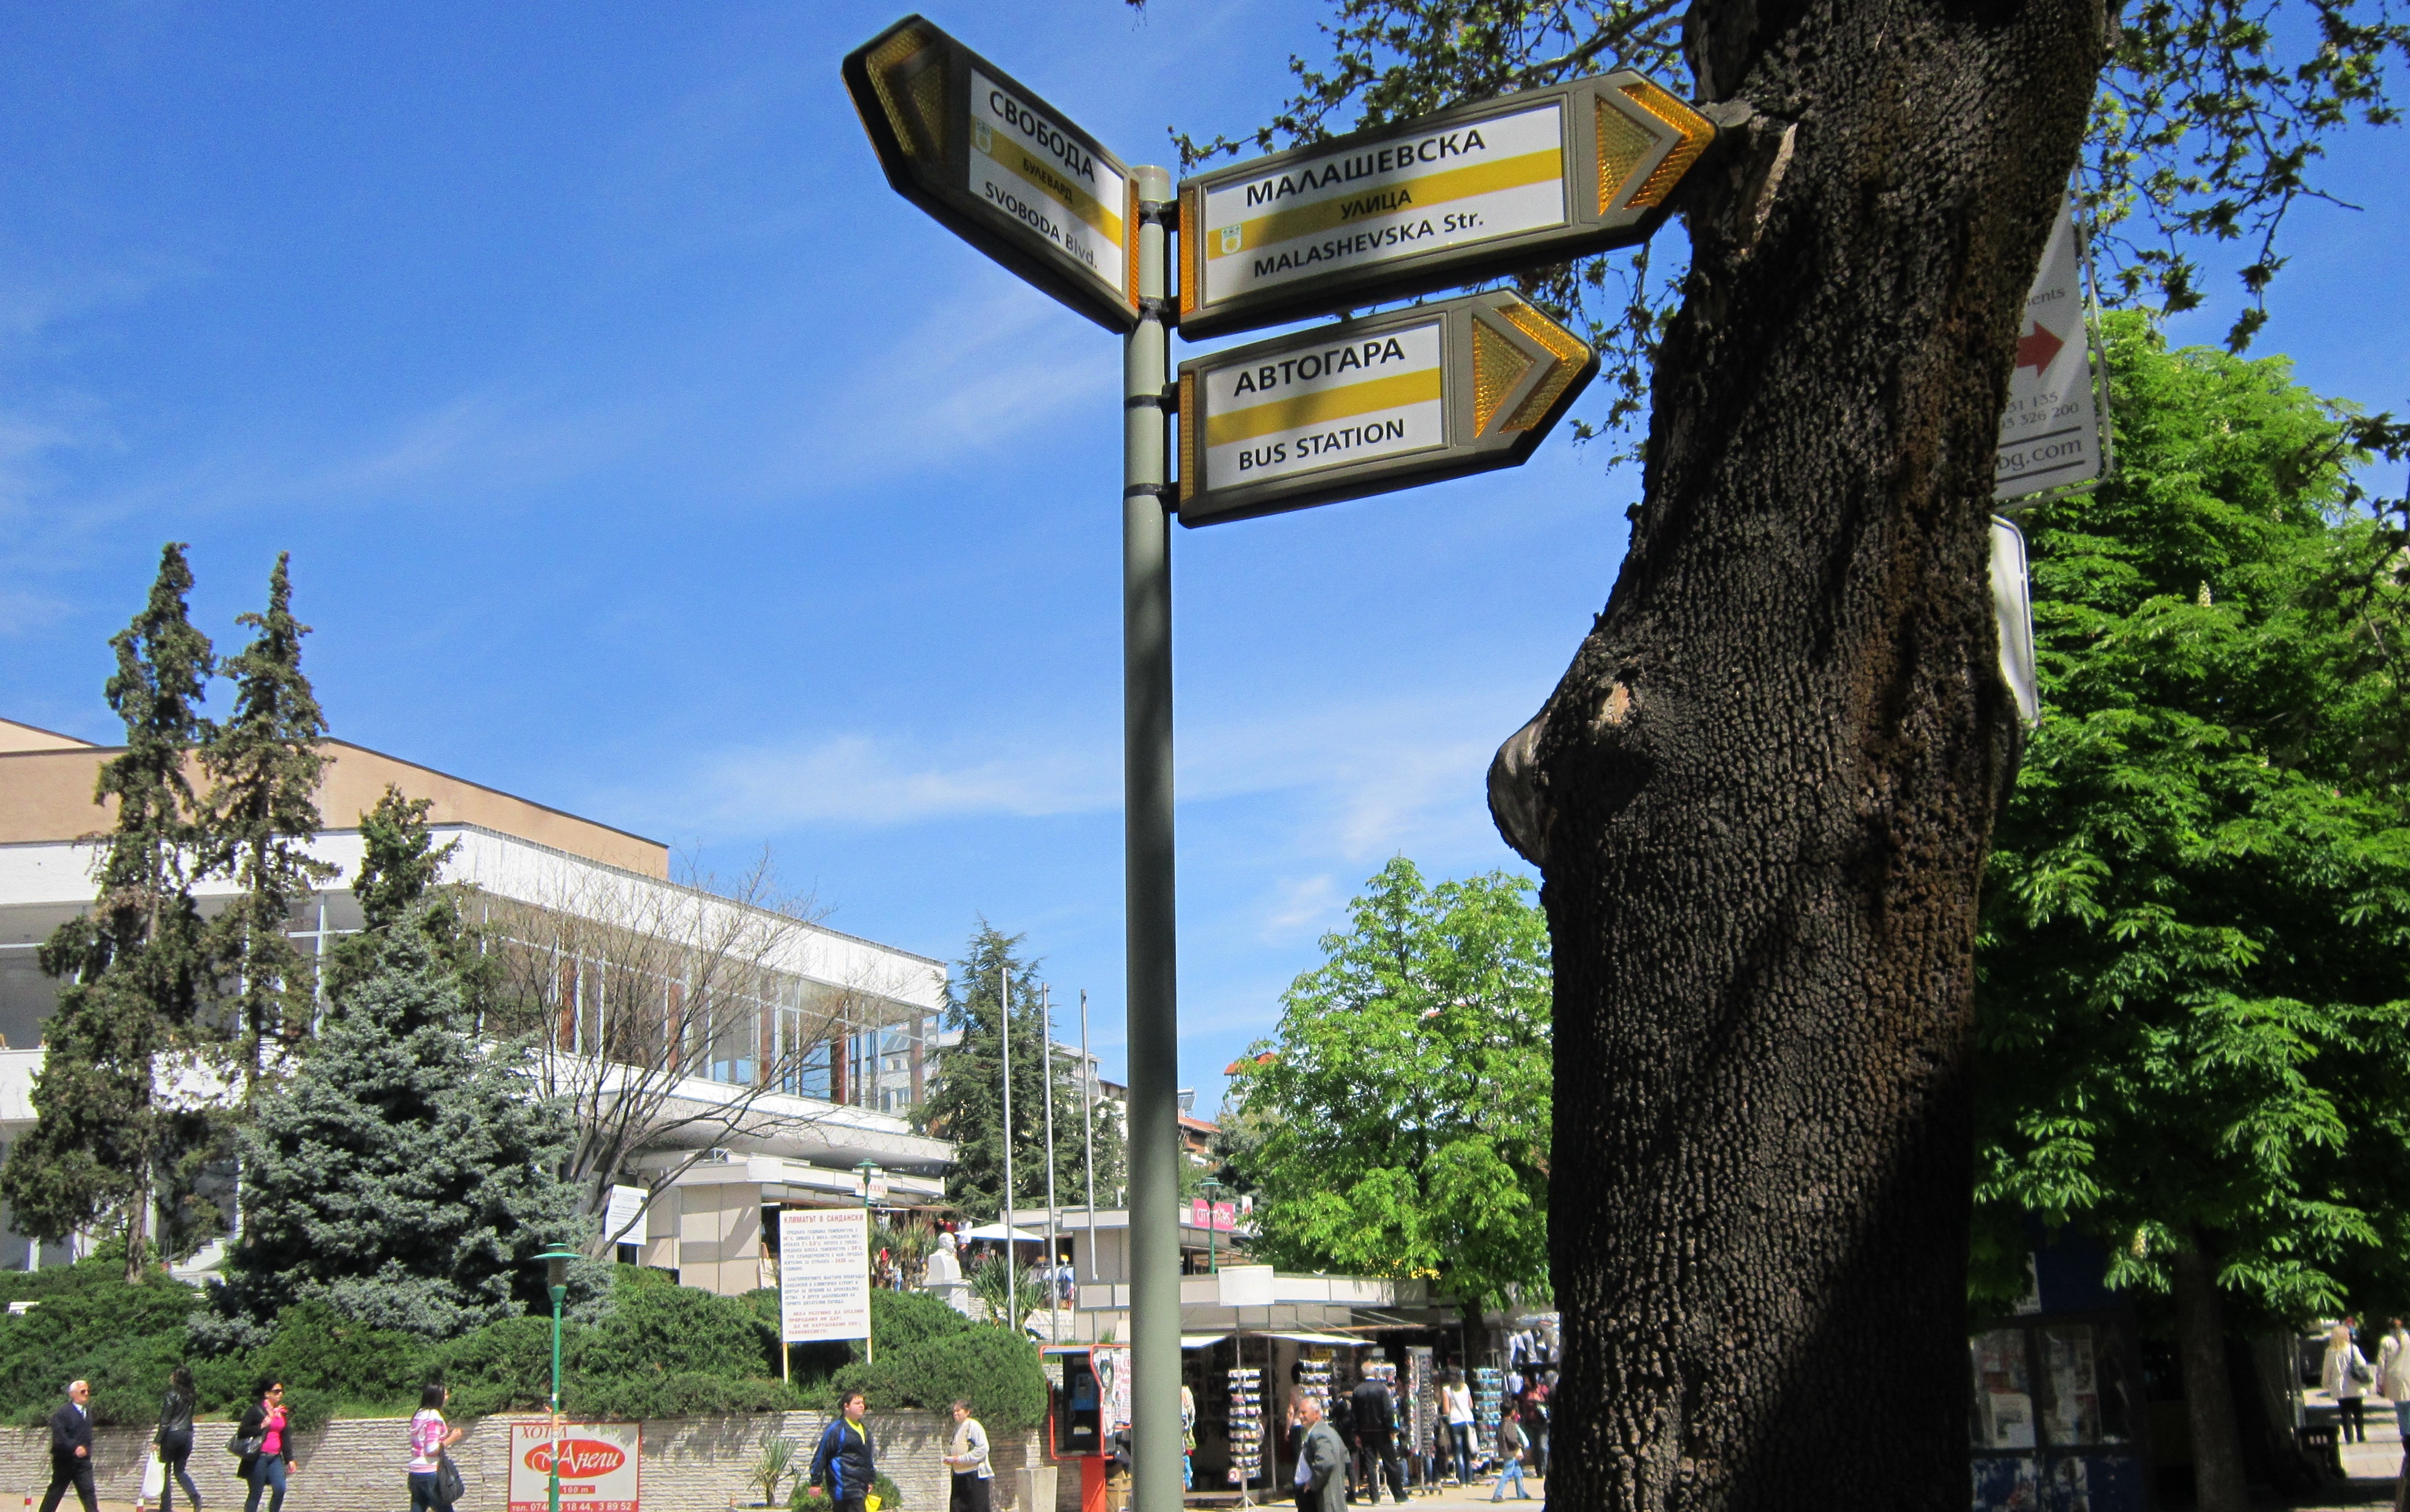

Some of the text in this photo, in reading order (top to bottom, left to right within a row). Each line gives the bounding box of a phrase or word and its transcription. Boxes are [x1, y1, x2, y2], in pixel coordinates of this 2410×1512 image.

[989, 89, 1095, 184] СВОБОДА
[1022, 157, 1074, 204] БУЛЕВАРД
[1246, 128, 1486, 208] МАЛАШЕВСКА
[984, 181, 1098, 270] SVOBODA Blvd.
[1340, 189, 1412, 220] УЛИЦА
[1253, 210, 1484, 279] MALASHEVSKA Str.
[1233, 337, 1406, 397] АВТОГАРА
[2052, 403, 2079, 418] 200
[1239, 418, 1405, 471] BUS STATION
[827, 1213, 863, 1223] САНДАНСКИ
[521, 1426, 567, 1439] ХОТЛ
[532, 1440, 620, 1474] Анели
[530, 1503, 550, 1512] 074
[566, 1502, 577, 1511] 18
[579, 1502, 593, 1512] 44,
[607, 1502, 618, 1510] 89
[620, 1502, 632, 1510] 52
